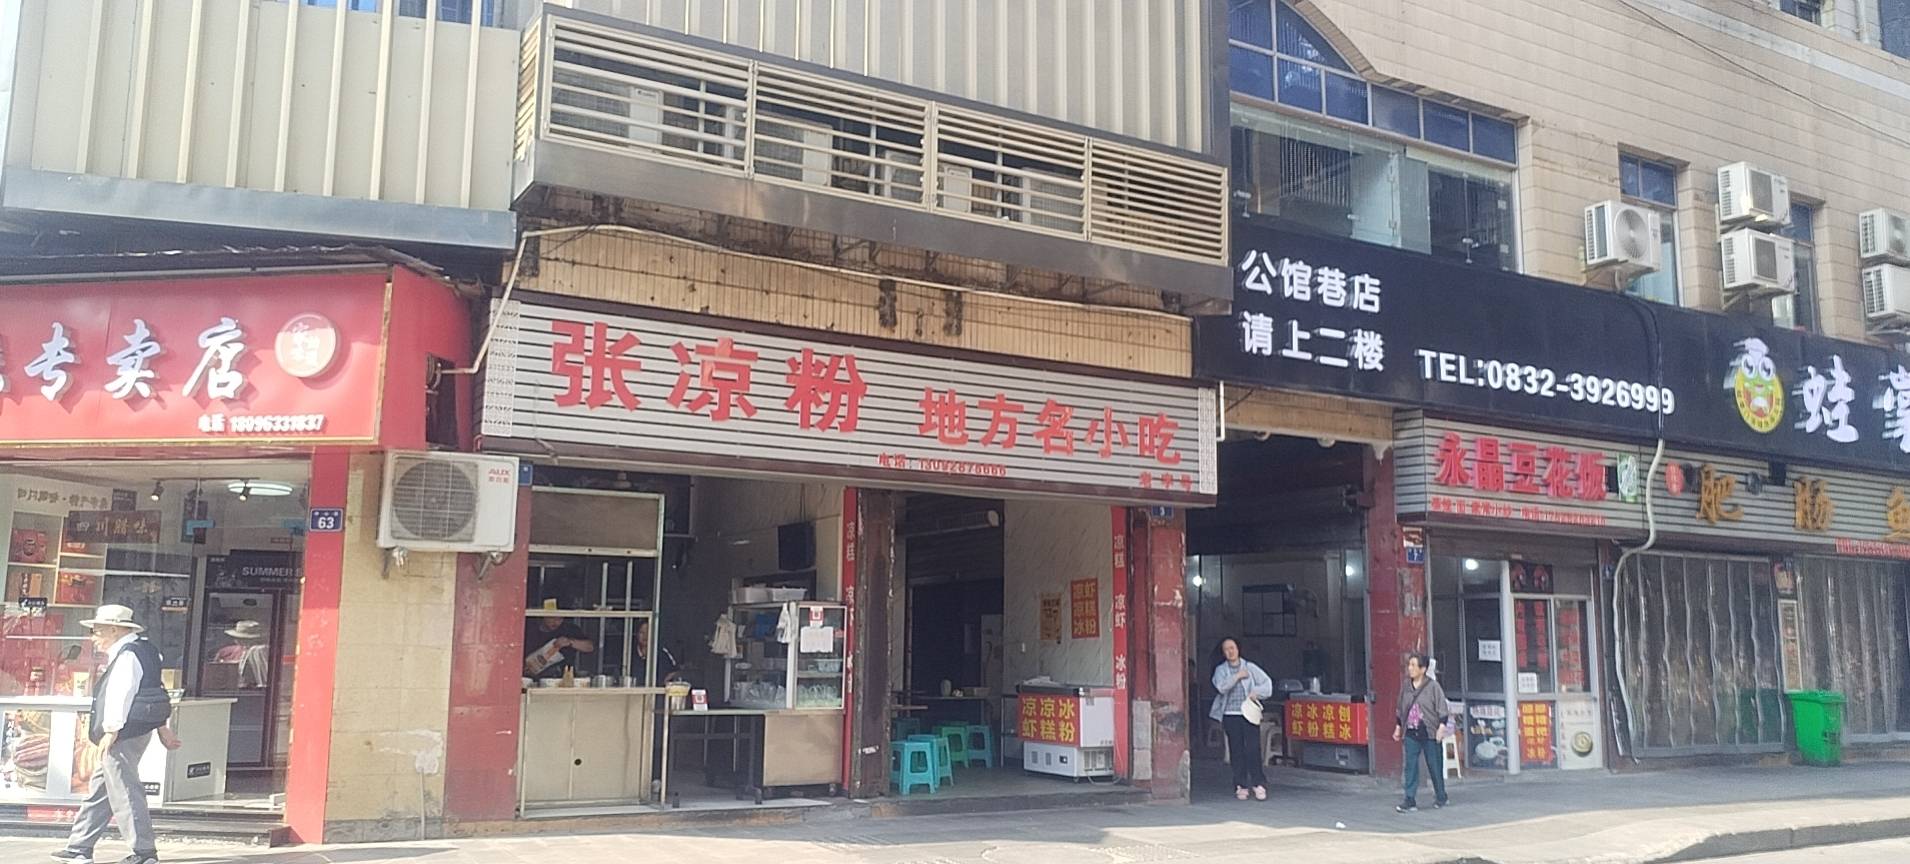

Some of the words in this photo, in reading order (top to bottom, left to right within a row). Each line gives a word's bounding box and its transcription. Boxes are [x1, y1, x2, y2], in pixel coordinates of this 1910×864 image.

[1240, 249, 1381, 313] 公馆巷店
[0, 317, 245, 401] 专卖店
[1240, 310, 1384, 371] 请上二楼
[551, 320, 867, 433] 张凉粉
[918, 386, 1182, 465] 地方名小吃
[1416, 349, 1676, 415] TEL:0832-3926999
[1434, 431, 1607, 502] 永晶豆花饭
[317, 516, 335, 529] 63
[242, 565, 294, 577] SUMMER
[1115, 593, 1126, 629] 凉虾
[1115, 655, 1127, 689] 冰粉
